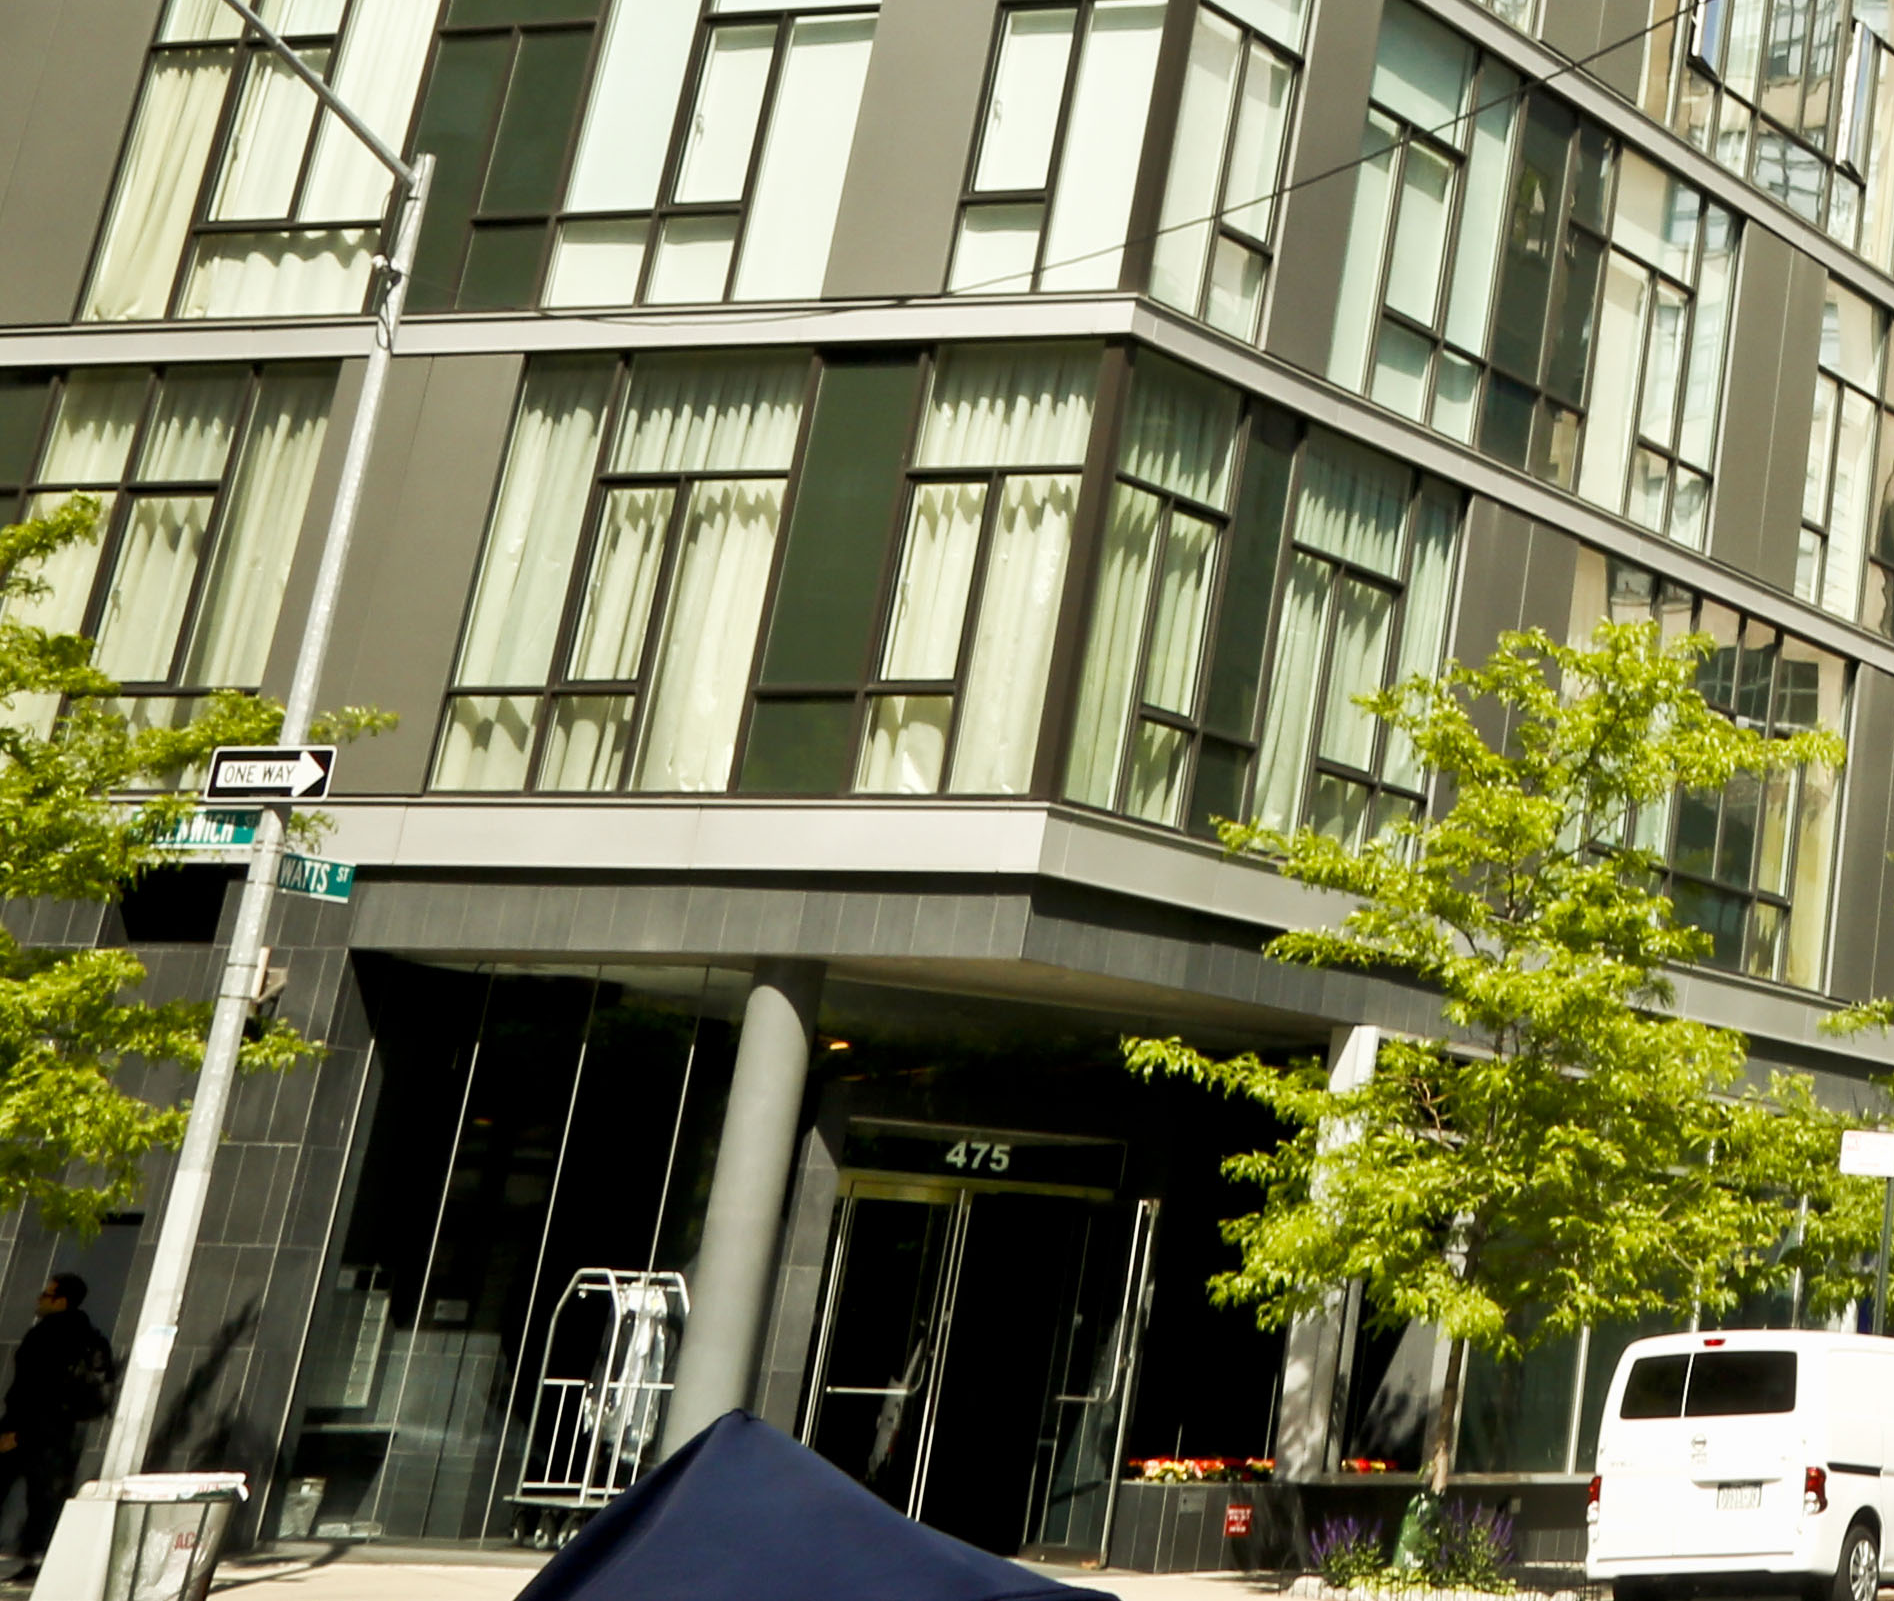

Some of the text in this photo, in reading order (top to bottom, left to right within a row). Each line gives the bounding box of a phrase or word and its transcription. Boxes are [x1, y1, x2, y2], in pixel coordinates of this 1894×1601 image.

[224, 764, 297, 784] ONE WAY
[280, 857, 350, 893] WATTS ST
[945, 1141, 1011, 1173] 475
